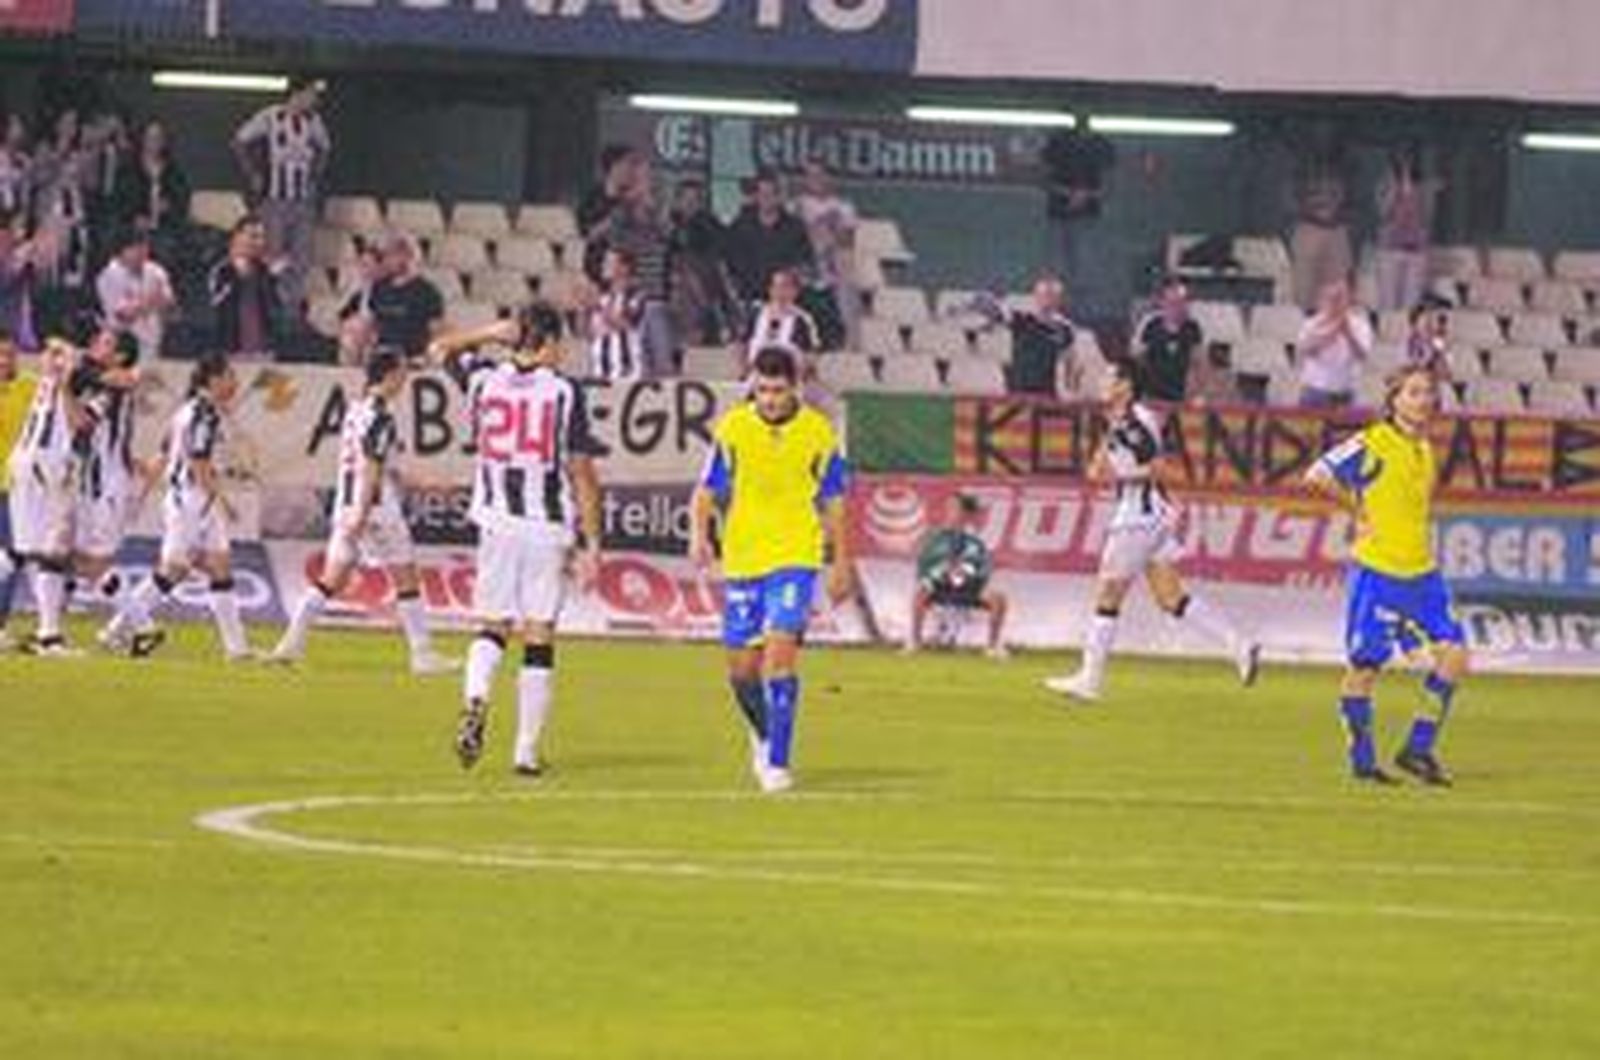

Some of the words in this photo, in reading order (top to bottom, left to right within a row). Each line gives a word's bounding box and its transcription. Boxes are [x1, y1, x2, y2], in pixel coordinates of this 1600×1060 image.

[654, 113, 840, 168] Esella
[842, 127, 996, 175] Damm
[479, 397, 556, 463] 24
